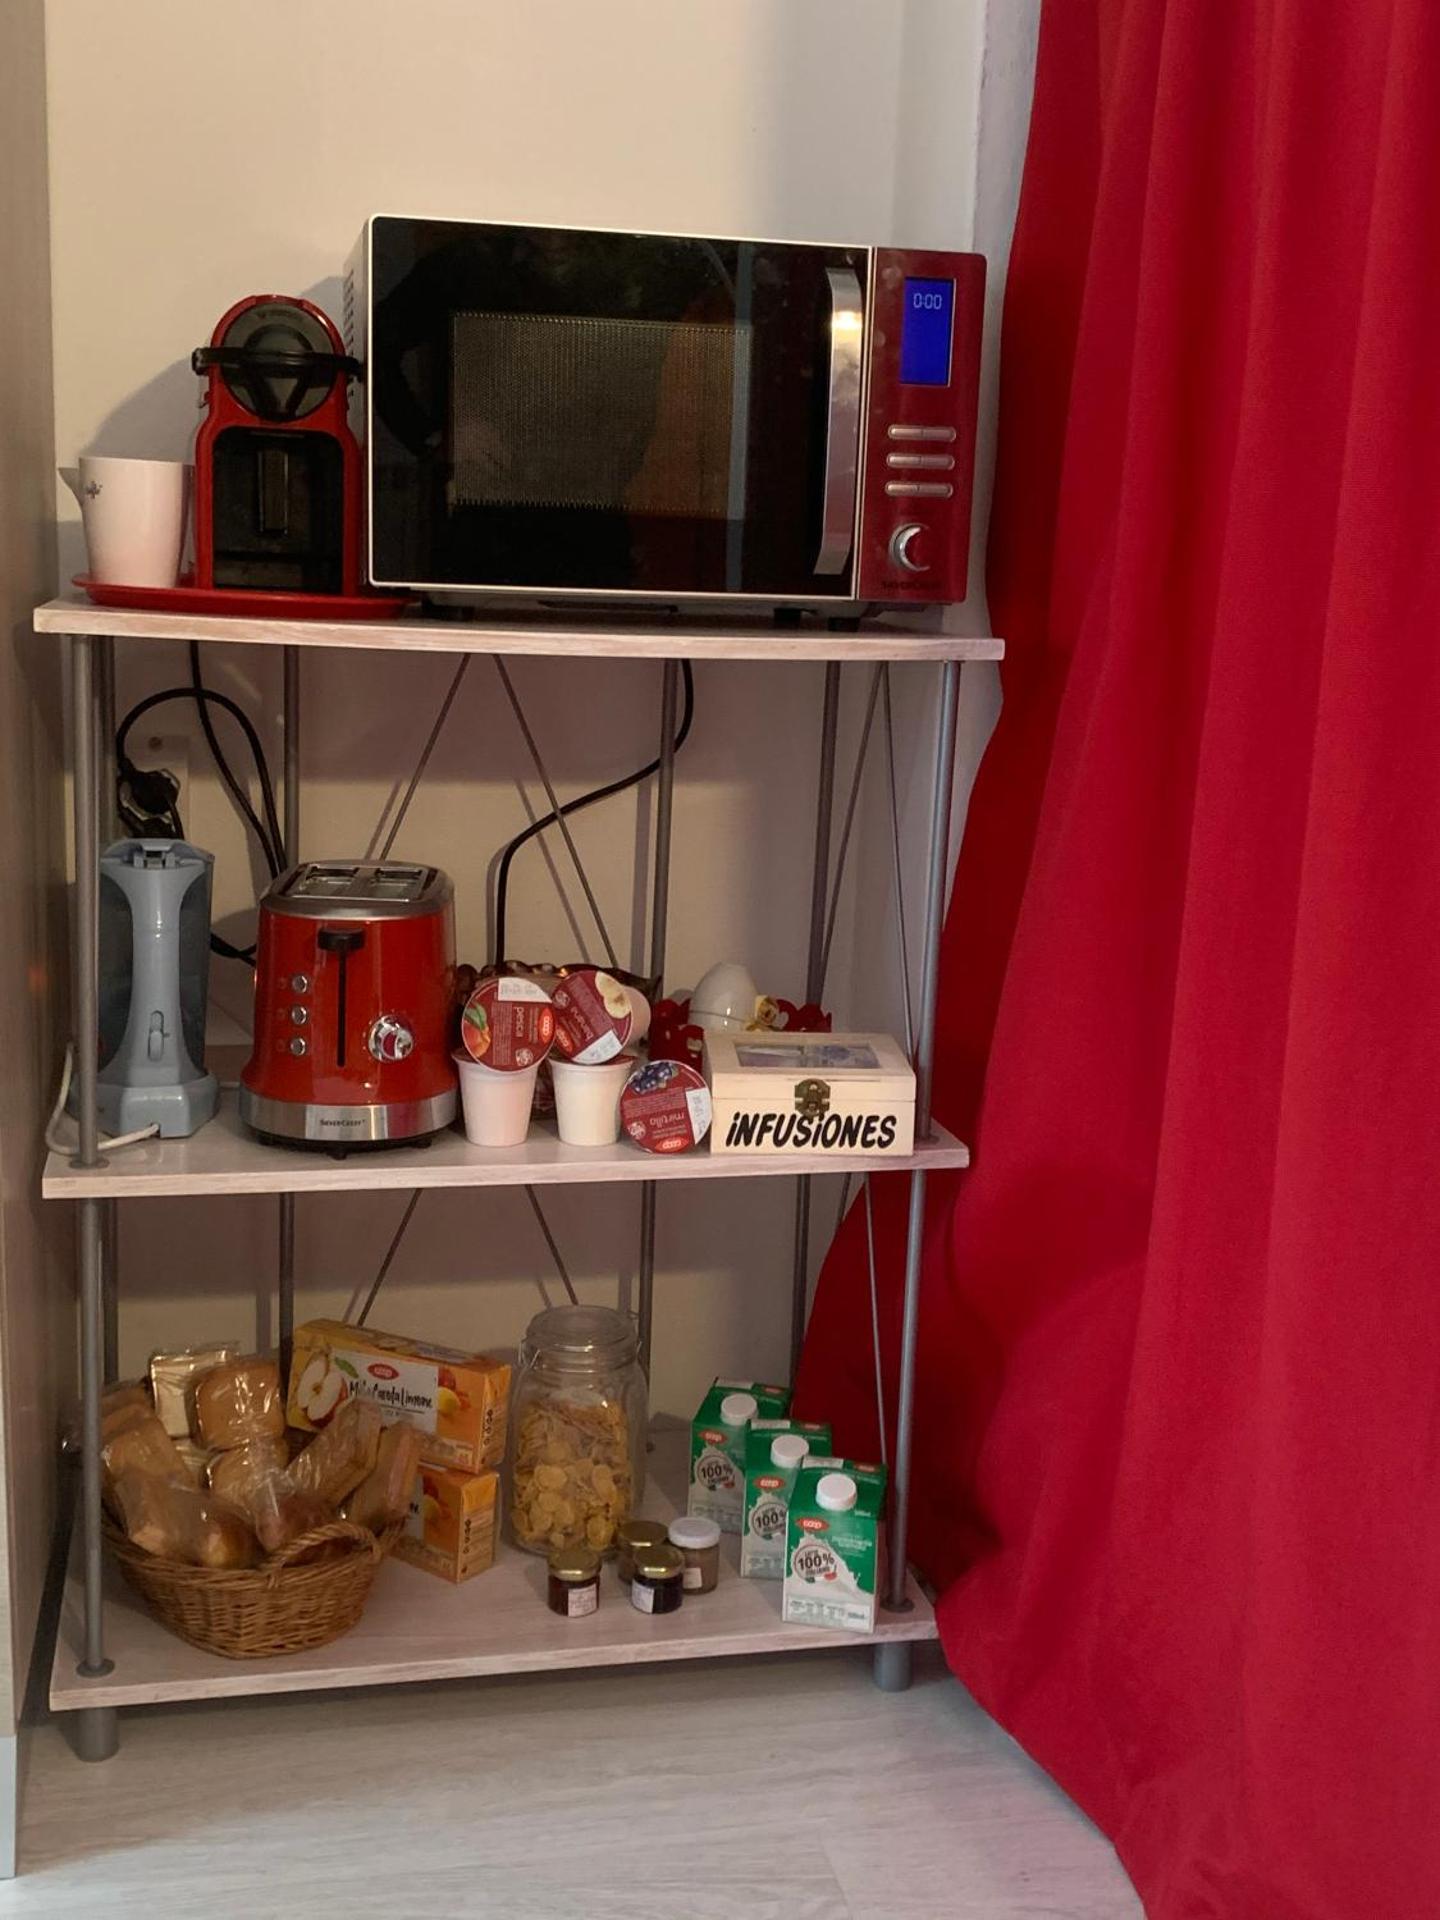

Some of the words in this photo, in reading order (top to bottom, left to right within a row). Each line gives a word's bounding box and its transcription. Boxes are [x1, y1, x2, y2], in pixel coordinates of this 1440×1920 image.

[913, 293, 942, 309] 0:00
[514, 1006, 525, 1037] pesca
[649, 1112, 685, 1128] mirtillo
[701, 1464, 733, 1480] 100%
[797, 1552, 835, 1571] 100%
